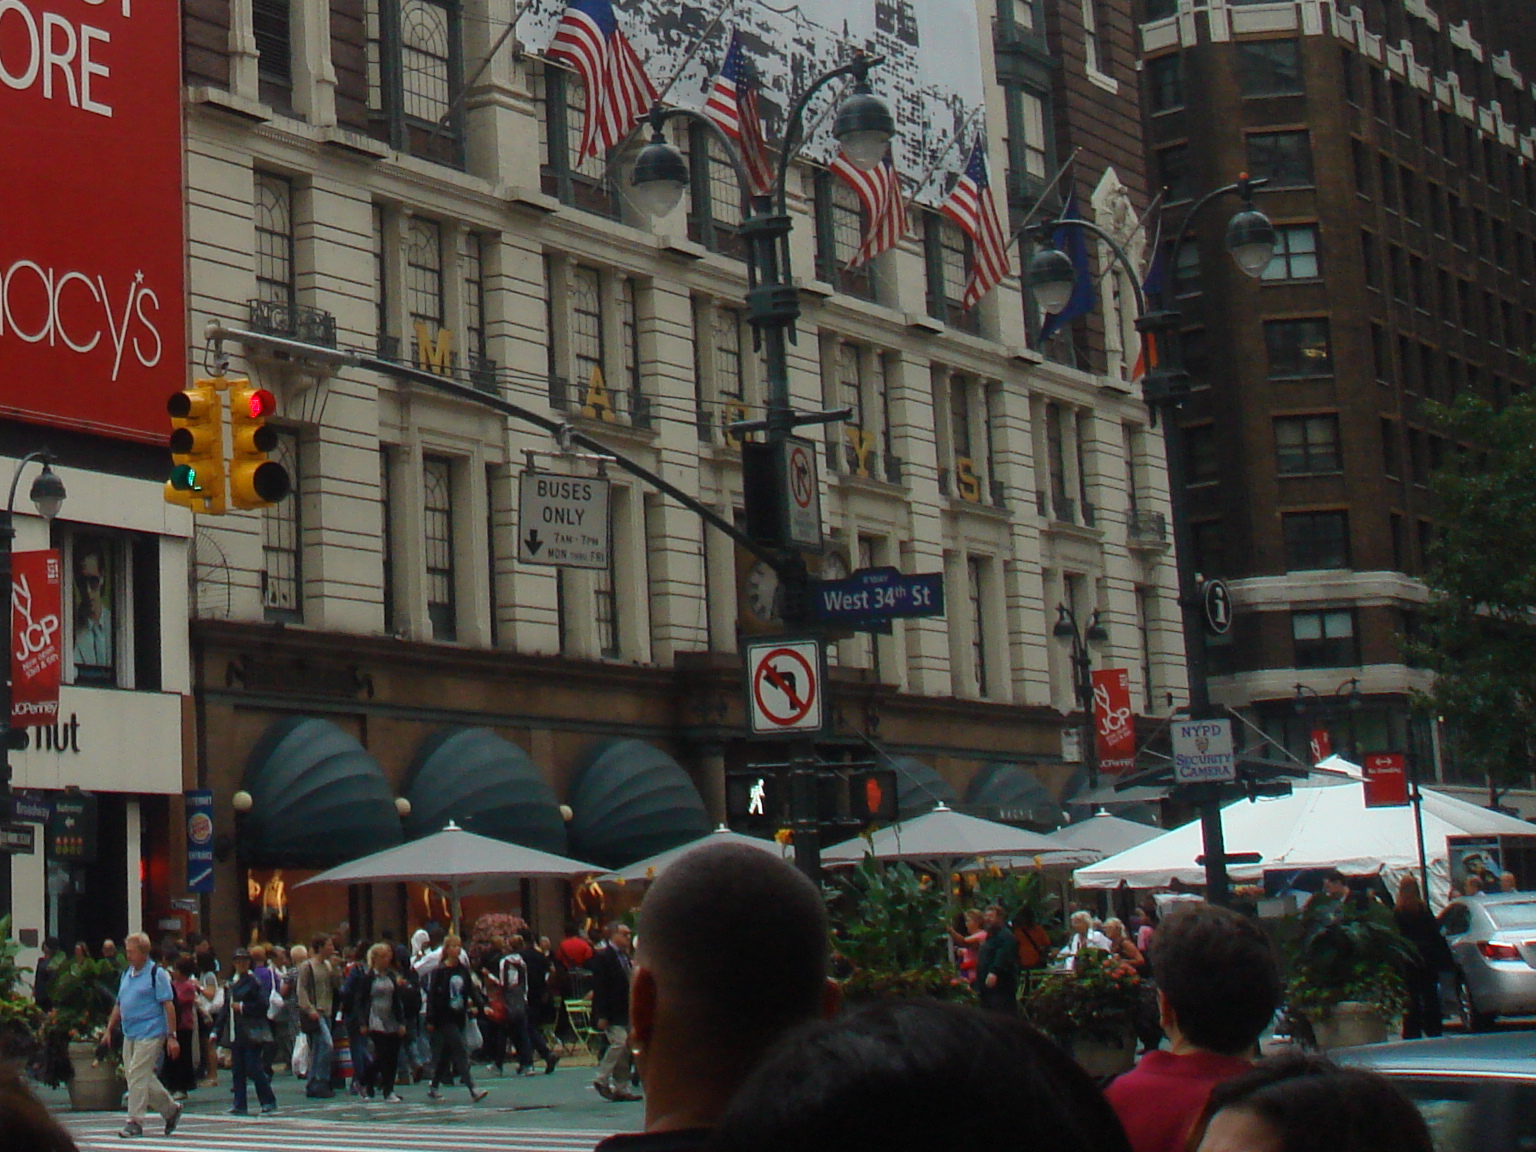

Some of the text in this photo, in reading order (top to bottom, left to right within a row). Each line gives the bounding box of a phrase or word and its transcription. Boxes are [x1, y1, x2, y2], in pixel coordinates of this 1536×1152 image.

[537, 479, 592, 501] BUSES
[542, 505, 585, 526] ONLY
[548, 547, 567, 560] MON
[590, 550, 605, 562] FRI
[823, 584, 931, 611] West 34th St
[16, 614, 59, 661] JCP
[11, 701, 58, 716] JCPenney
[1100, 707, 1130, 736] JCP
[1181, 724, 1221, 738] NYPD
[16, 801, 50, 819] Broadway
